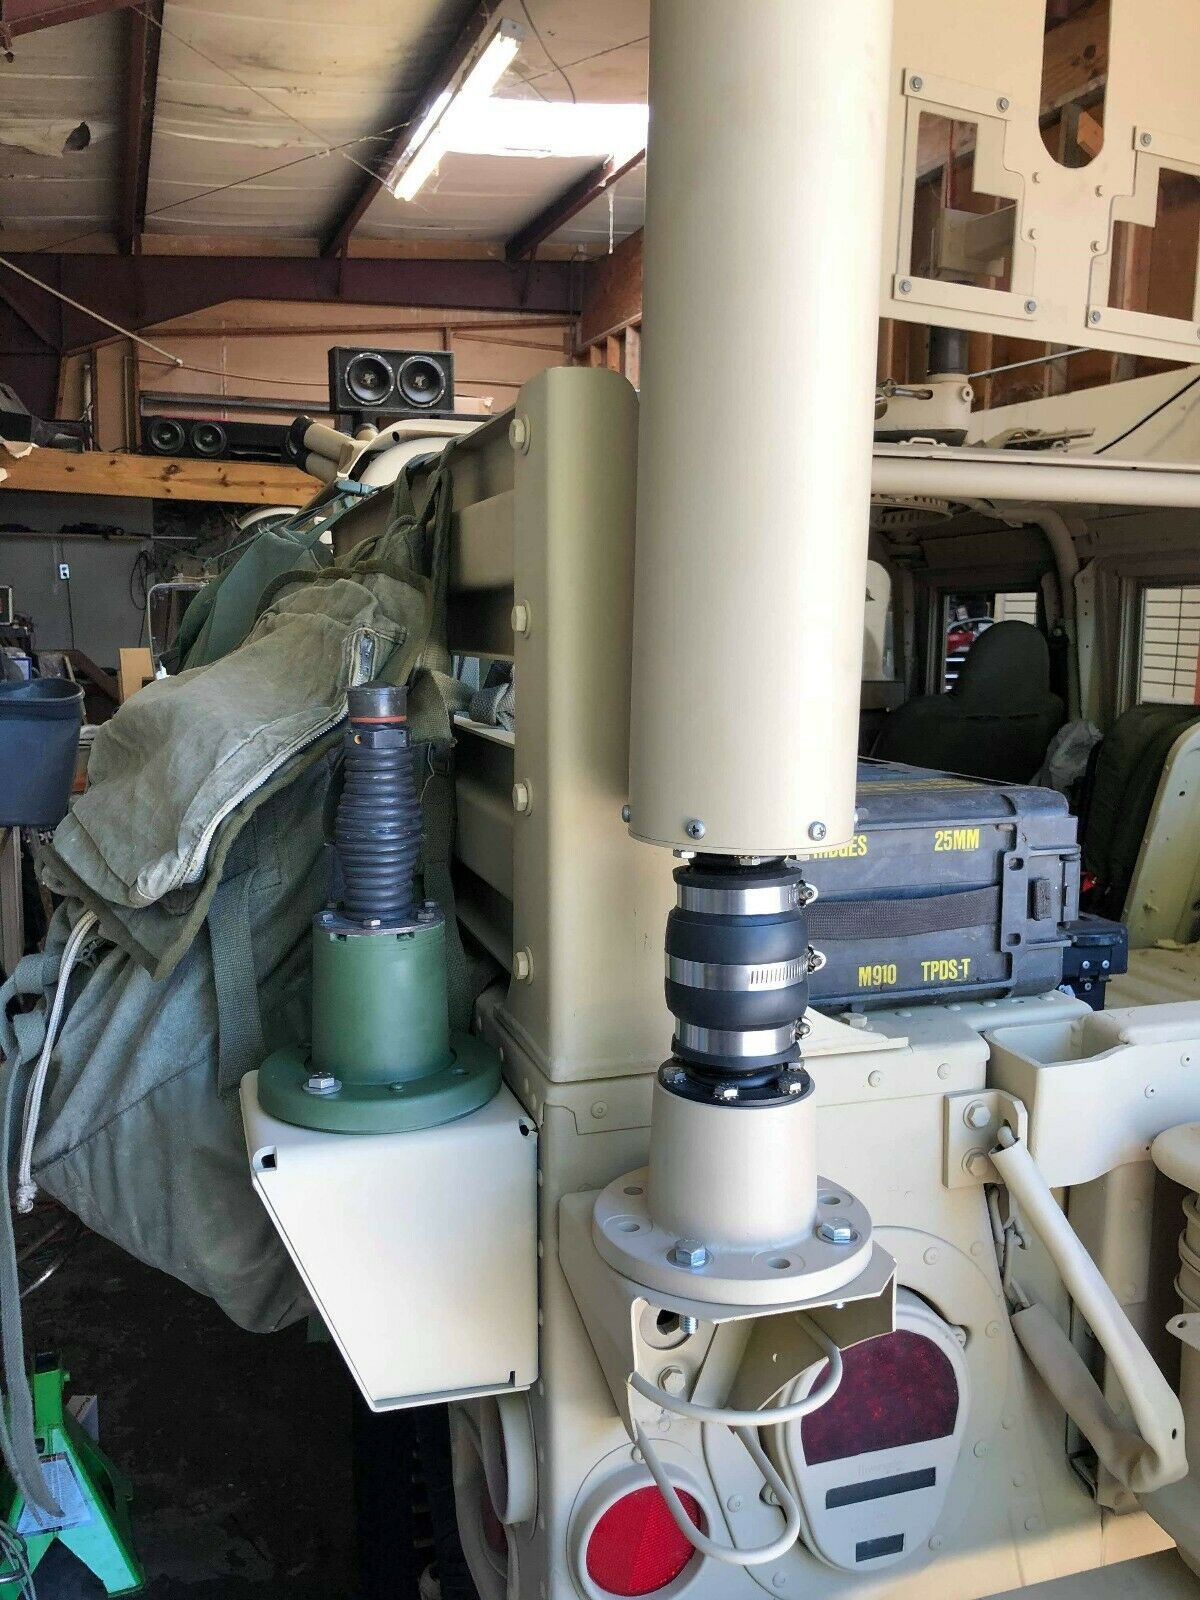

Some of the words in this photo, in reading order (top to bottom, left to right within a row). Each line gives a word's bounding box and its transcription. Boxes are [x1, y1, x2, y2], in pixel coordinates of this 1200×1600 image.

[934, 828, 980, 852] 25MM
[858, 963, 897, 987] M910
[921, 958, 971, 982] TPDS-T
